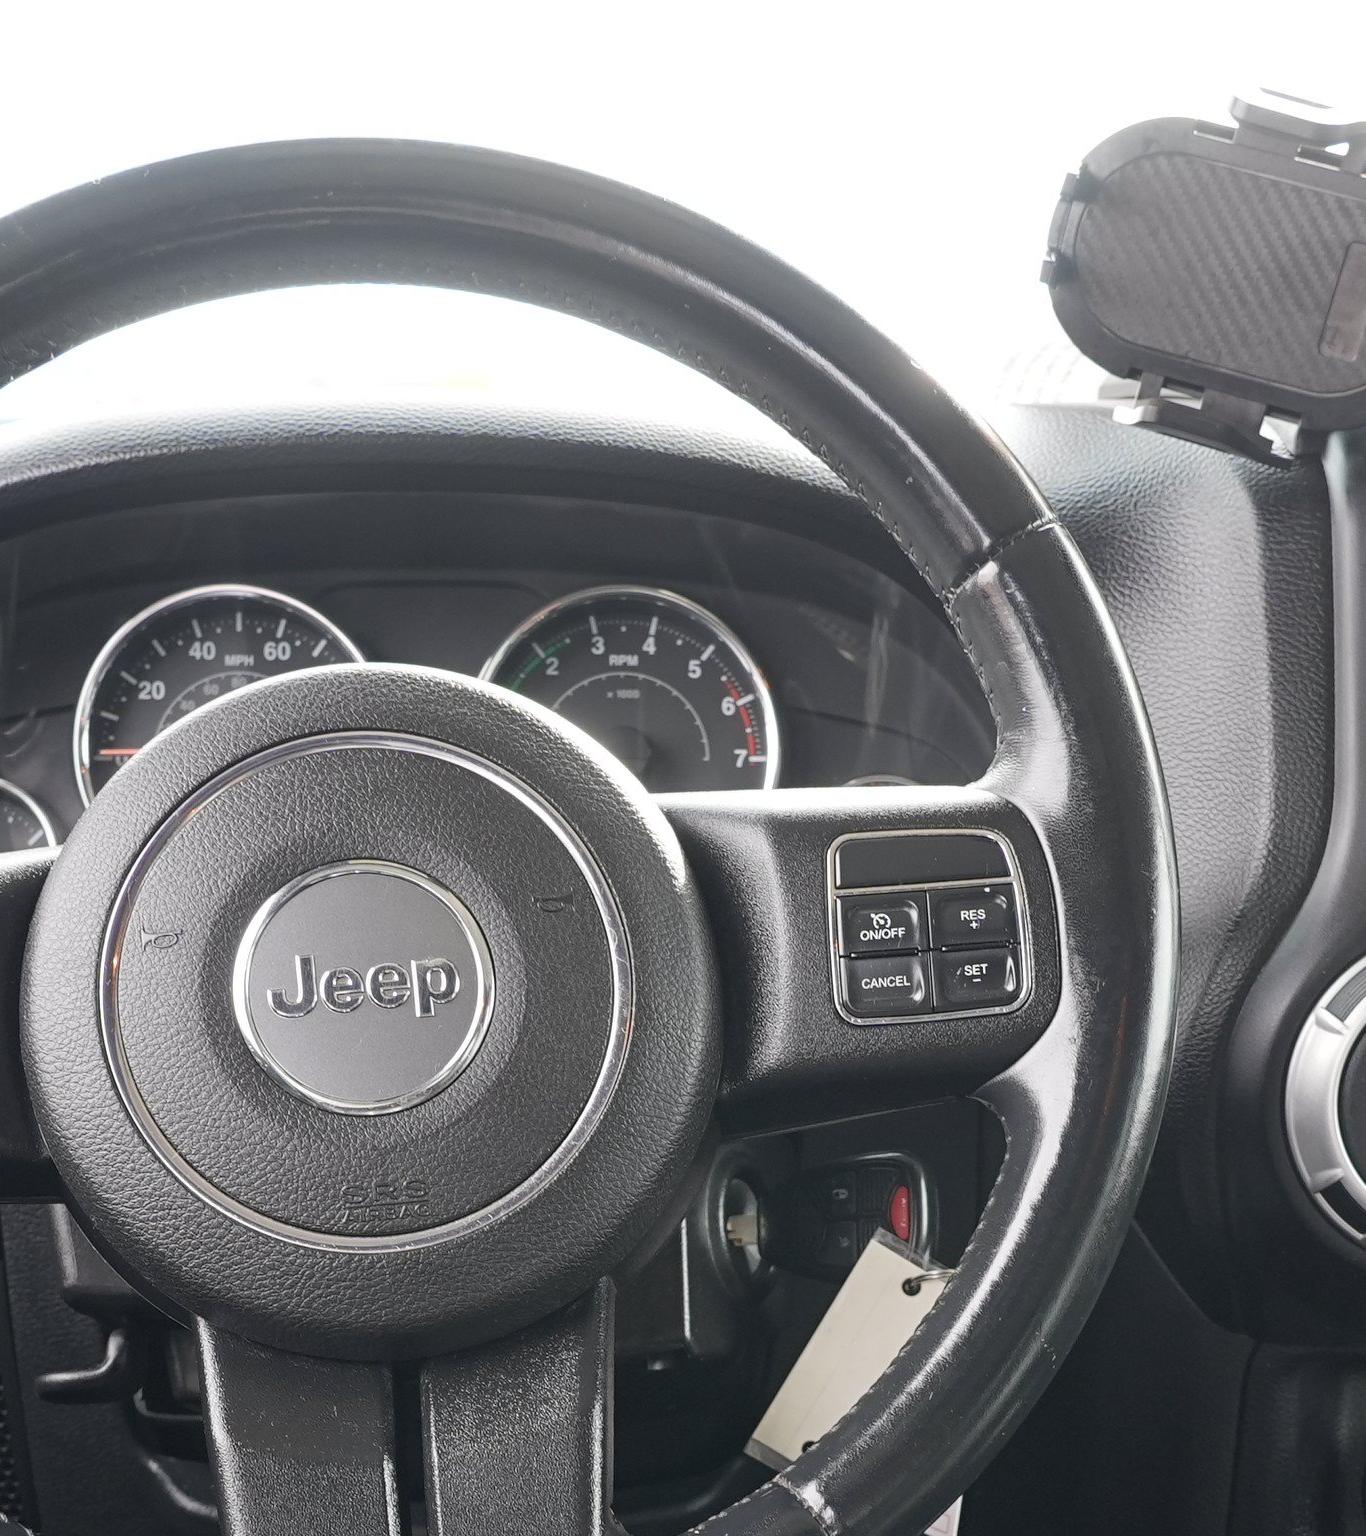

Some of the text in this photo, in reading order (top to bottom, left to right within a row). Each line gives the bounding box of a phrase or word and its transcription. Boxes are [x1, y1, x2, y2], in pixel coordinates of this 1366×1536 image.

[188, 640, 216, 661] 40
[263, 640, 291, 661] 60
[591, 636, 605, 655] 3
[642, 636, 657, 656] 4
[224, 654, 254, 667] MPH
[545, 657, 560, 675] 2
[608, 654, 640, 666] RPM
[687, 659, 702, 679] 5
[138, 681, 166, 701] 20
[720, 696, 736, 716] 6
[733, 749, 748, 768] 7
[960, 909, 987, 922] RES
[859, 926, 906, 941] ON/OFF
[963, 963, 989, 977] SET
[266, 955, 461, 1018] Jeep
[861, 975, 911, 989] CANCEL
[340, 1180, 429, 1204] SRS
